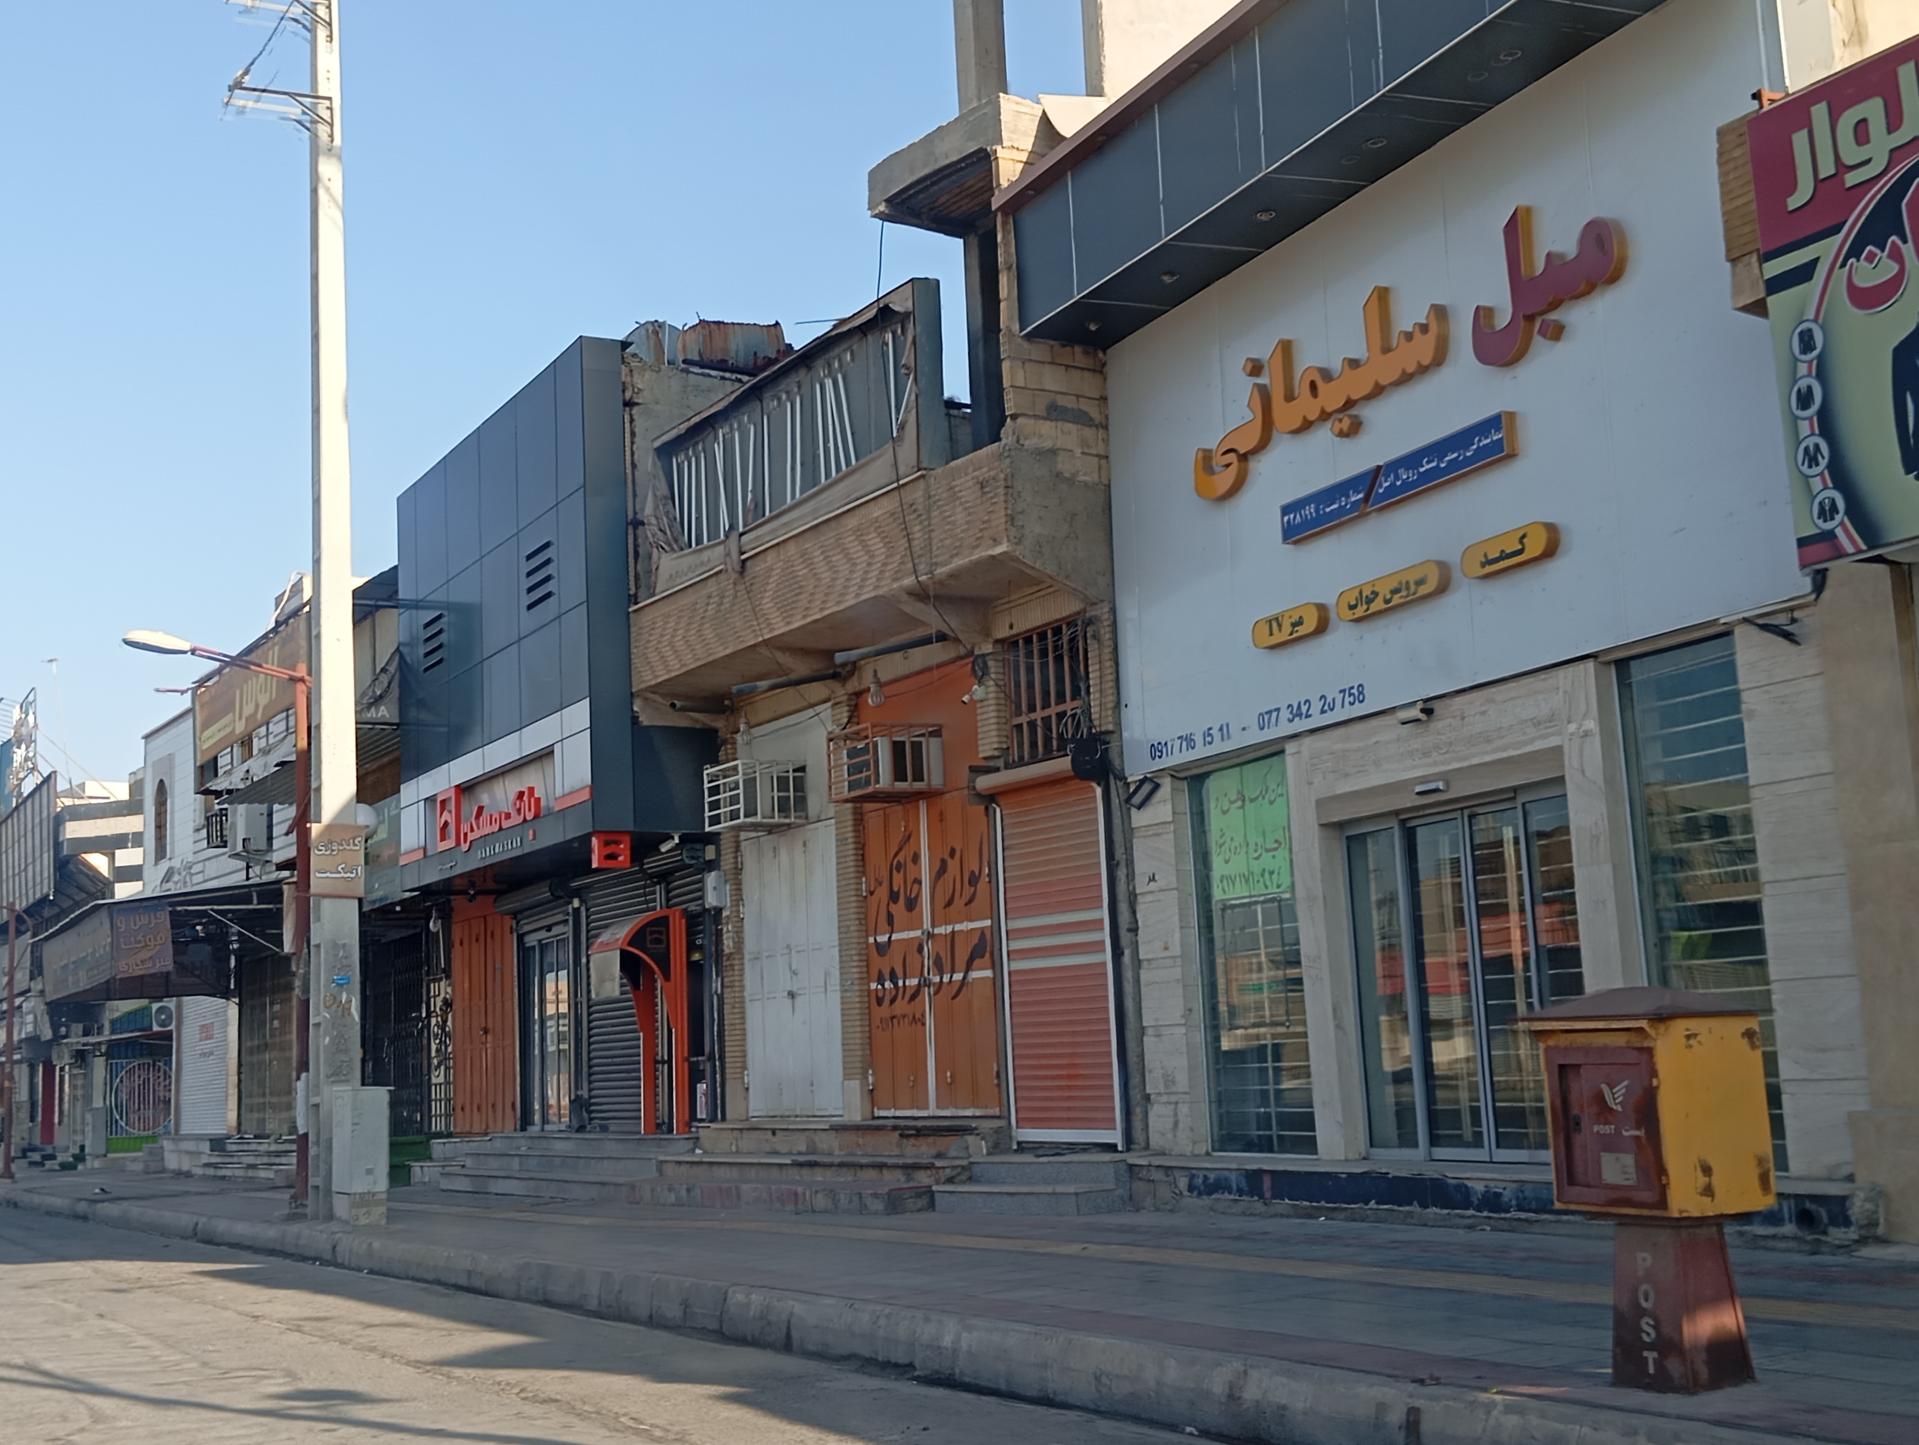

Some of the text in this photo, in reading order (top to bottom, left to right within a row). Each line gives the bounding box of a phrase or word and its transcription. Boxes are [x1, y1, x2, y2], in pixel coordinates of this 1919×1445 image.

[1194, 205, 1628, 499] مبل سلیمانی
[1439, 447, 1464, 468] رسمی
[1480, 532, 1528, 569] کمد
[1347, 573, 1428, 616] سرویس خواب
[1265, 613, 1305, 637] میز TV
[1257, 706, 1282, 731] 077
[1286, 698, 1312, 724] 342
[1338, 683, 1366, 709] 758
[460, 804, 500, 853] مسکن
[1252, 825, 1288, 861] اجاره
[314, 863, 362, 881] اتیکت
[873, 829, 984, 958] لوازم خانگی
[1592, 1124, 1646, 1137] POST پست
[1636, 1252, 1659, 1376] POST
